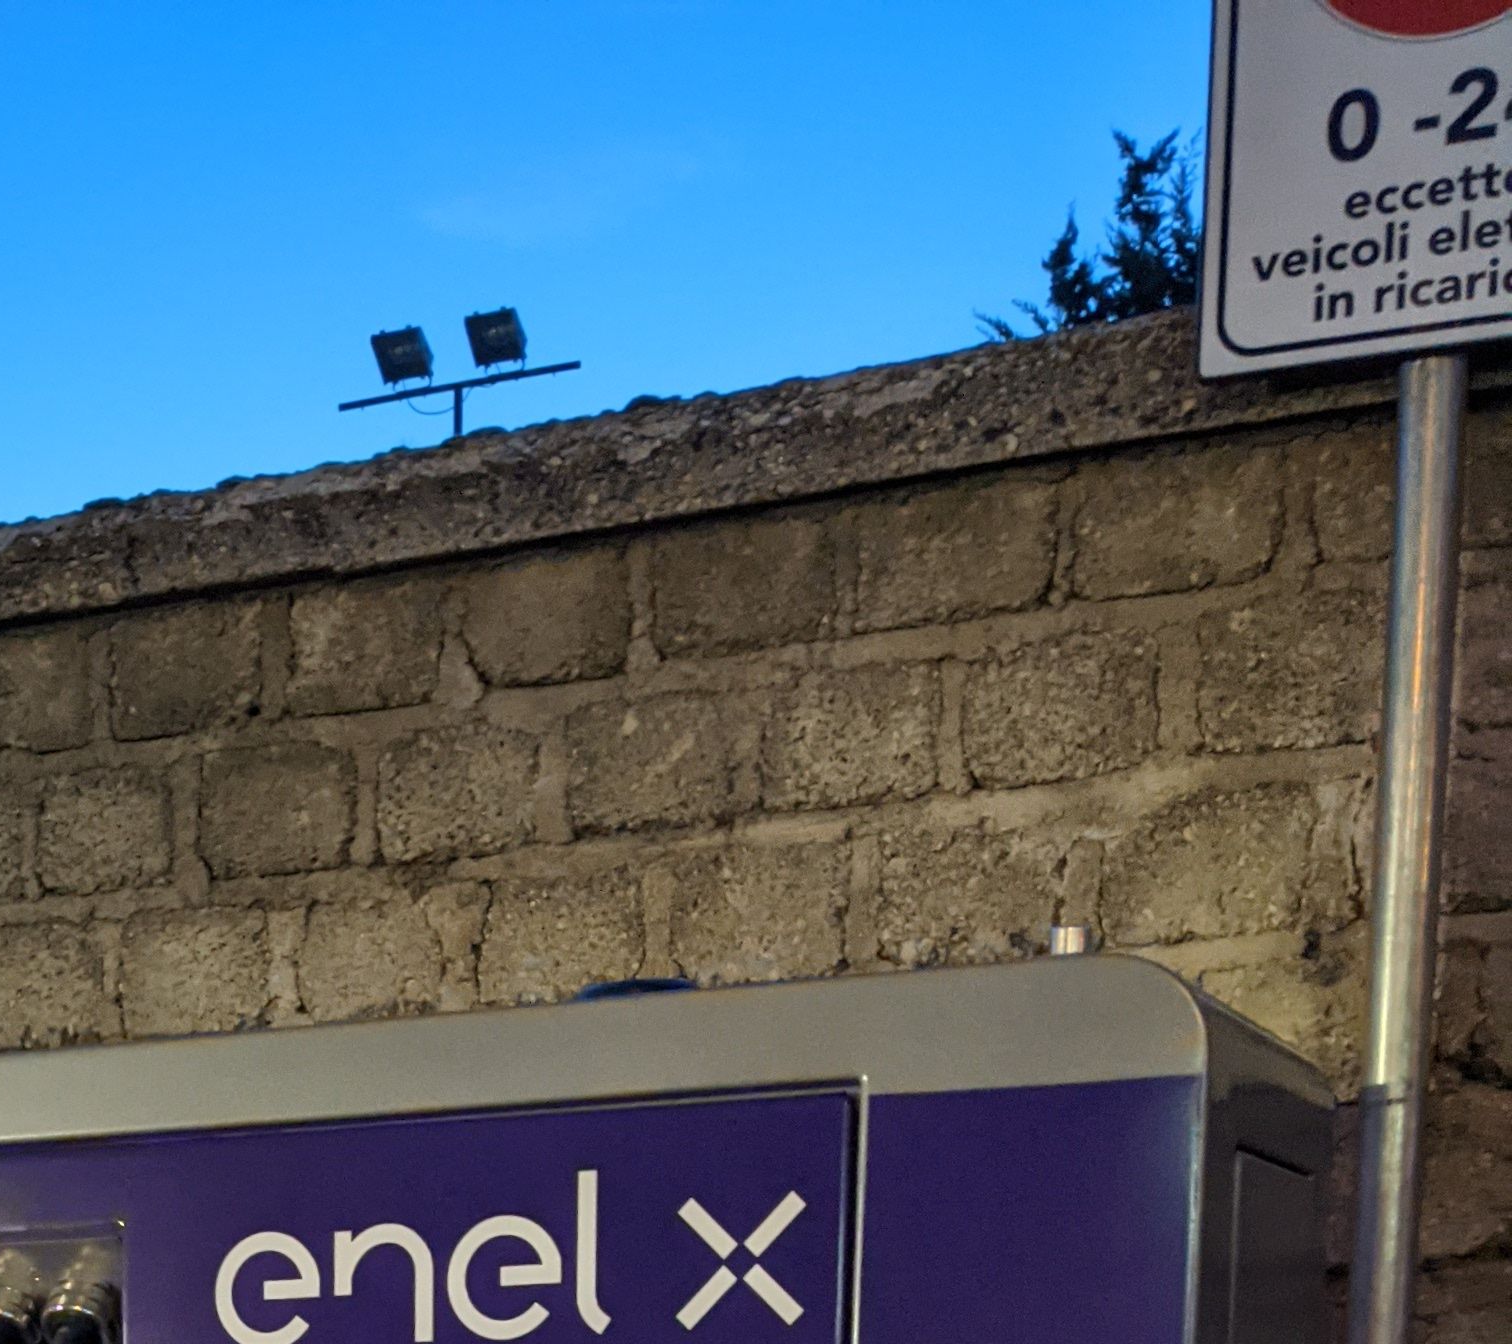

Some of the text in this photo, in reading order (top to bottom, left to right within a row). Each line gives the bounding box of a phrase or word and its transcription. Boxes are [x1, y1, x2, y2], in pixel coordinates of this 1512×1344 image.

[1328, 67, 1512, 162] 0 -2
[1252, 221, 1409, 282] veicoli
[1313, 283, 1354, 322] in
